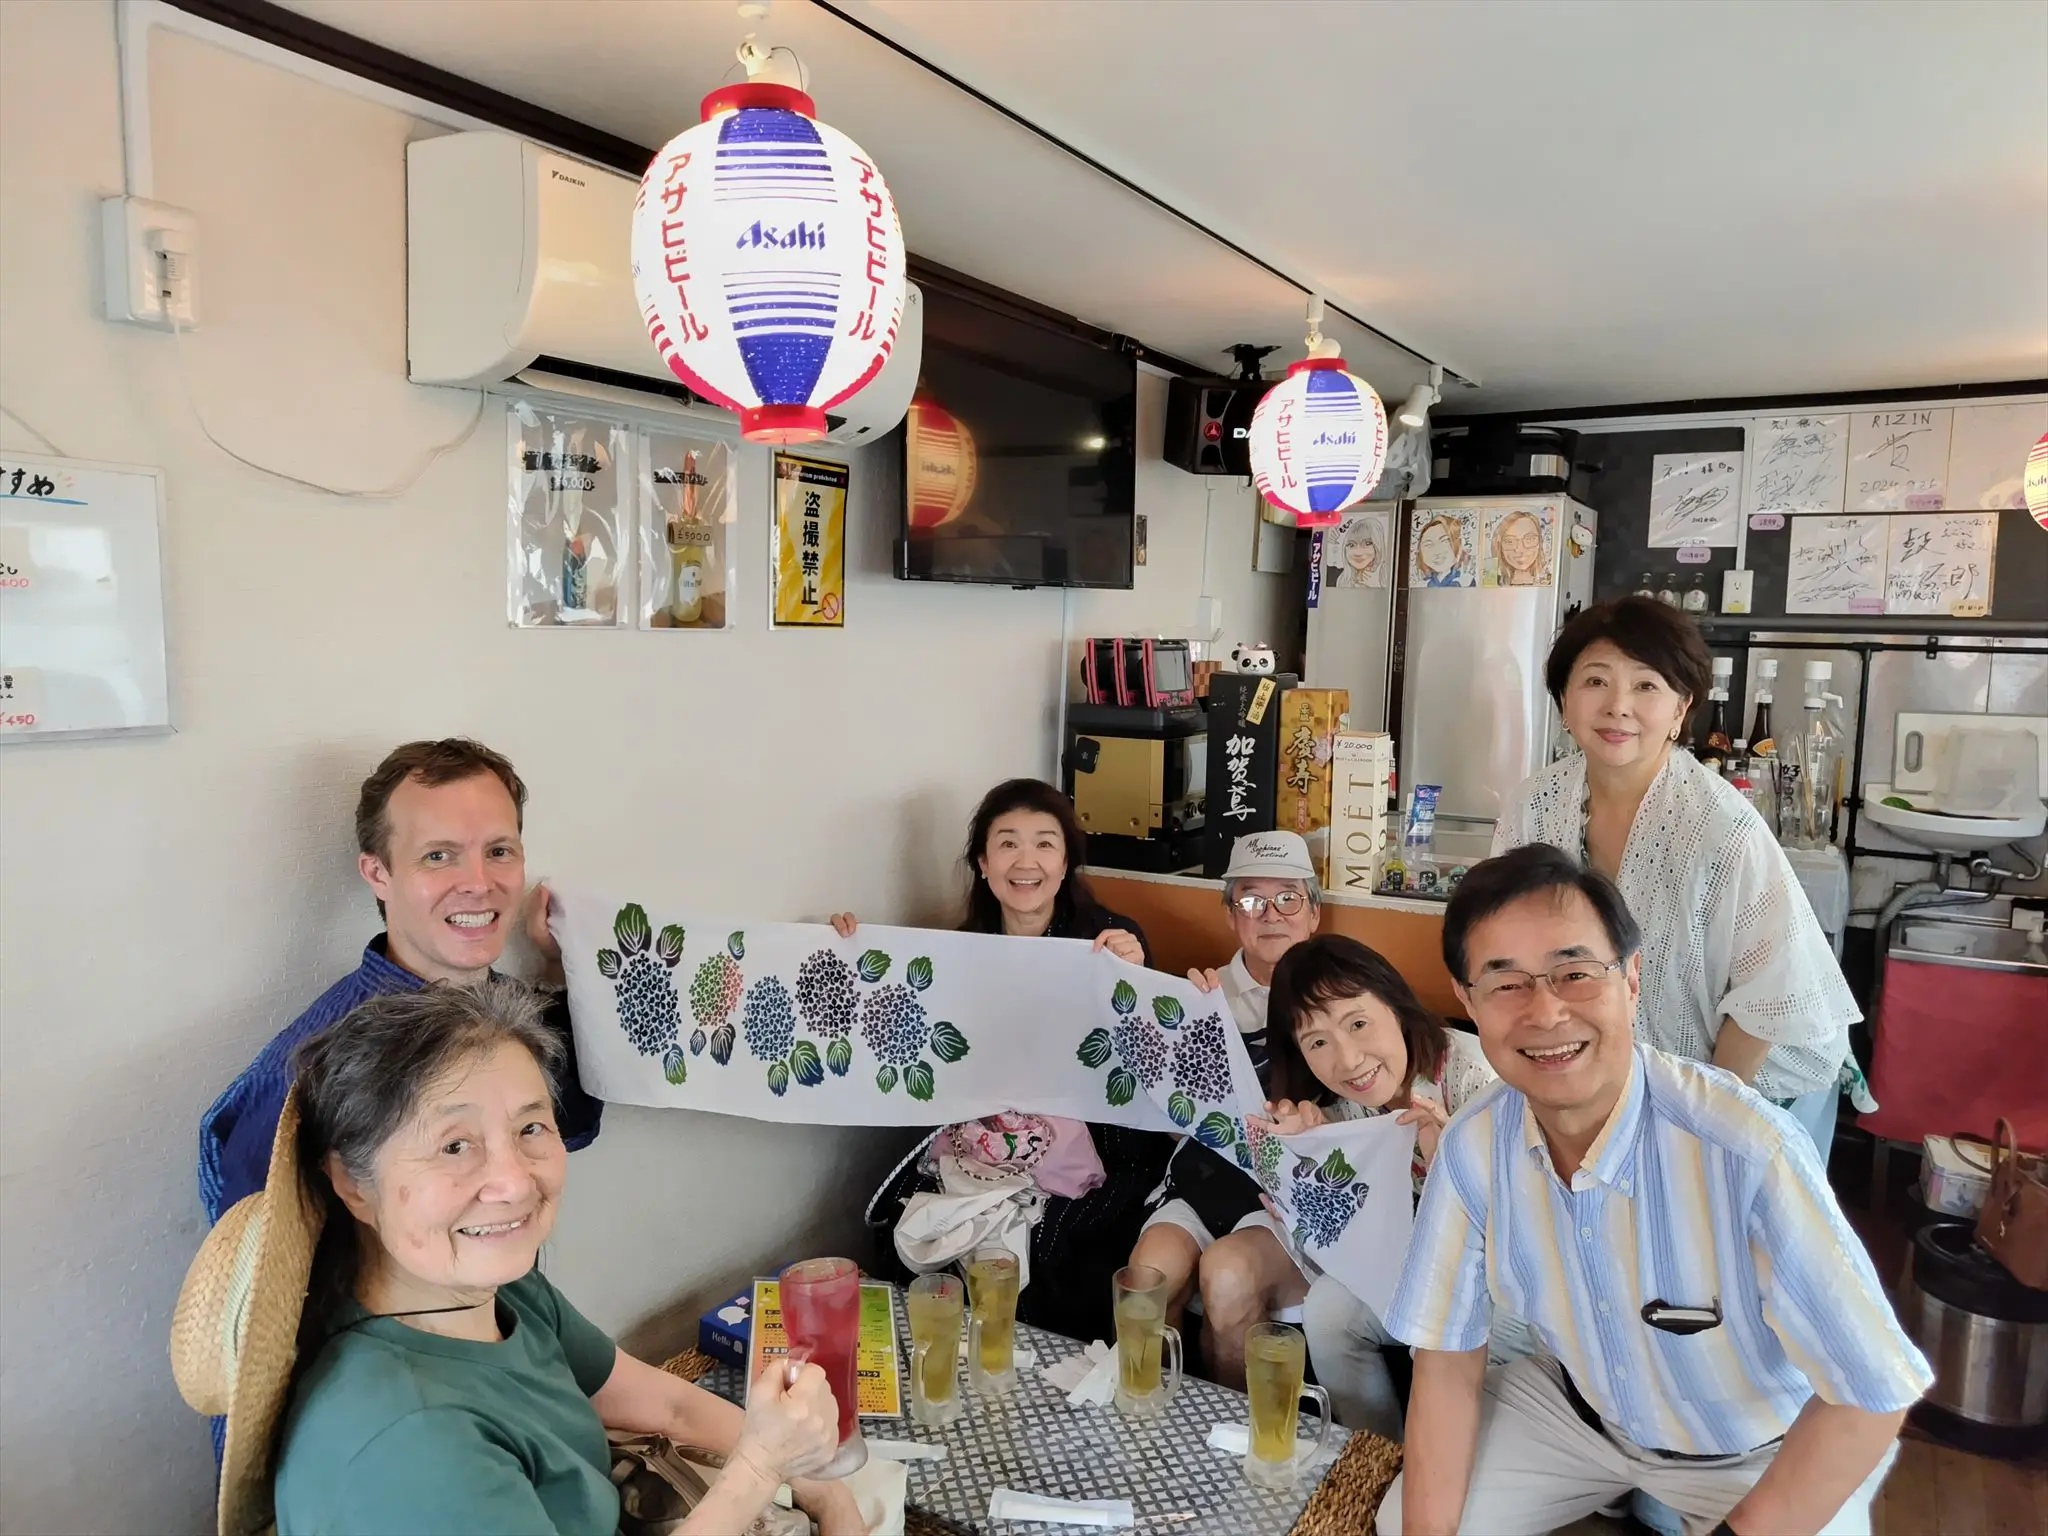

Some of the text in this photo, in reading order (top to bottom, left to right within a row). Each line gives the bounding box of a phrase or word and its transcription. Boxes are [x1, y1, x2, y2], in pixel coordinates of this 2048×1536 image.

[559, 174, 586, 188] DAIKIN
[660, 152, 709, 344] アサヒビール
[736, 219, 825, 250] Asahi
[849, 155, 887, 342] アサヒビール
[1276, 399, 1298, 489] アサヒビール
[1313, 431, 1356, 446] Asahi
[1363, 395, 1384, 484] アサヒビール
[1872, 410, 1932, 428] RIZIN
[801, 491, 821, 605] 盗撮禁止
[1308, 543, 1321, 600] アサヒビール
[1343, 773, 1375, 890] MOËT
[712, 1331, 731, 1347] Hello
